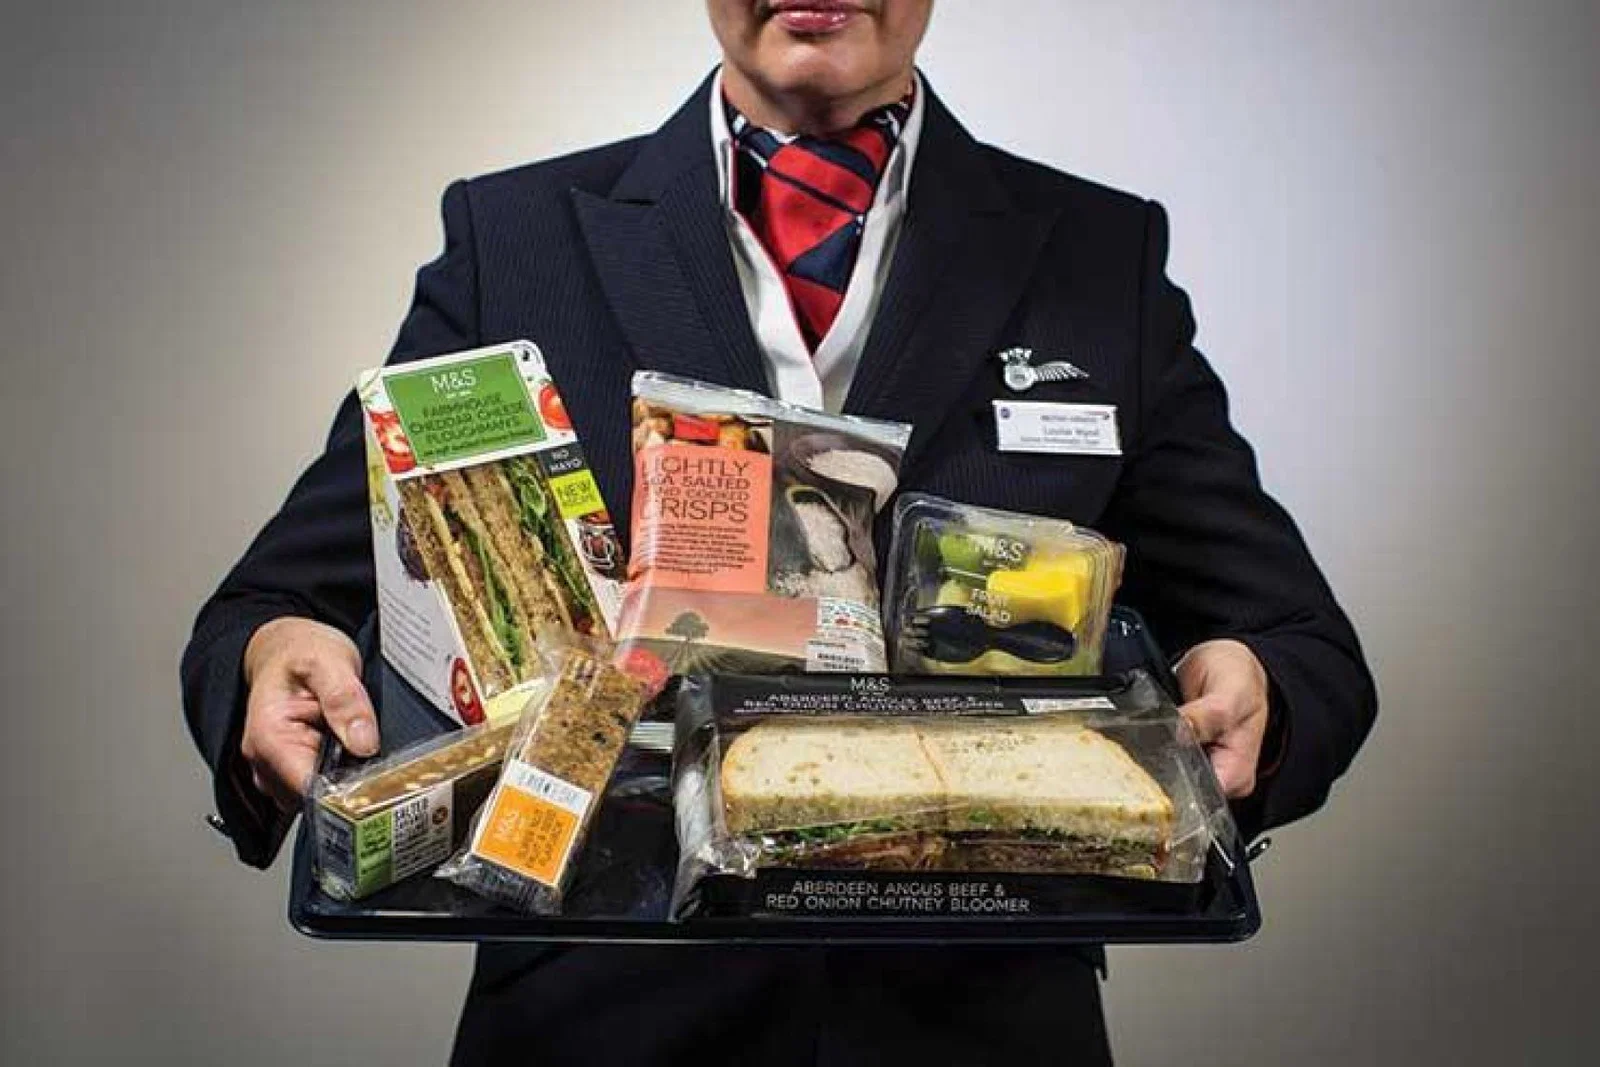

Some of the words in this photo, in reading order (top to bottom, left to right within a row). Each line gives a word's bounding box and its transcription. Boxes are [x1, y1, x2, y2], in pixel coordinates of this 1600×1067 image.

[430, 367, 478, 393] M&S
[409, 412, 473, 434] CHEDDAR
[556, 479, 592, 499] NEW
[683, 475, 751, 489] SALTED
[851, 677, 890, 691] M&S
[792, 880, 879, 895] ABERDEEN
[884, 881, 943, 896] ANGUS
[949, 882, 989, 897] BEEF
[994, 884, 1005, 897] &
[765, 893, 799, 910] RED
[804, 895, 861, 910] ONION
[867, 897, 945, 912] CHUTNEY
[951, 897, 1030, 912] BLOOMER
